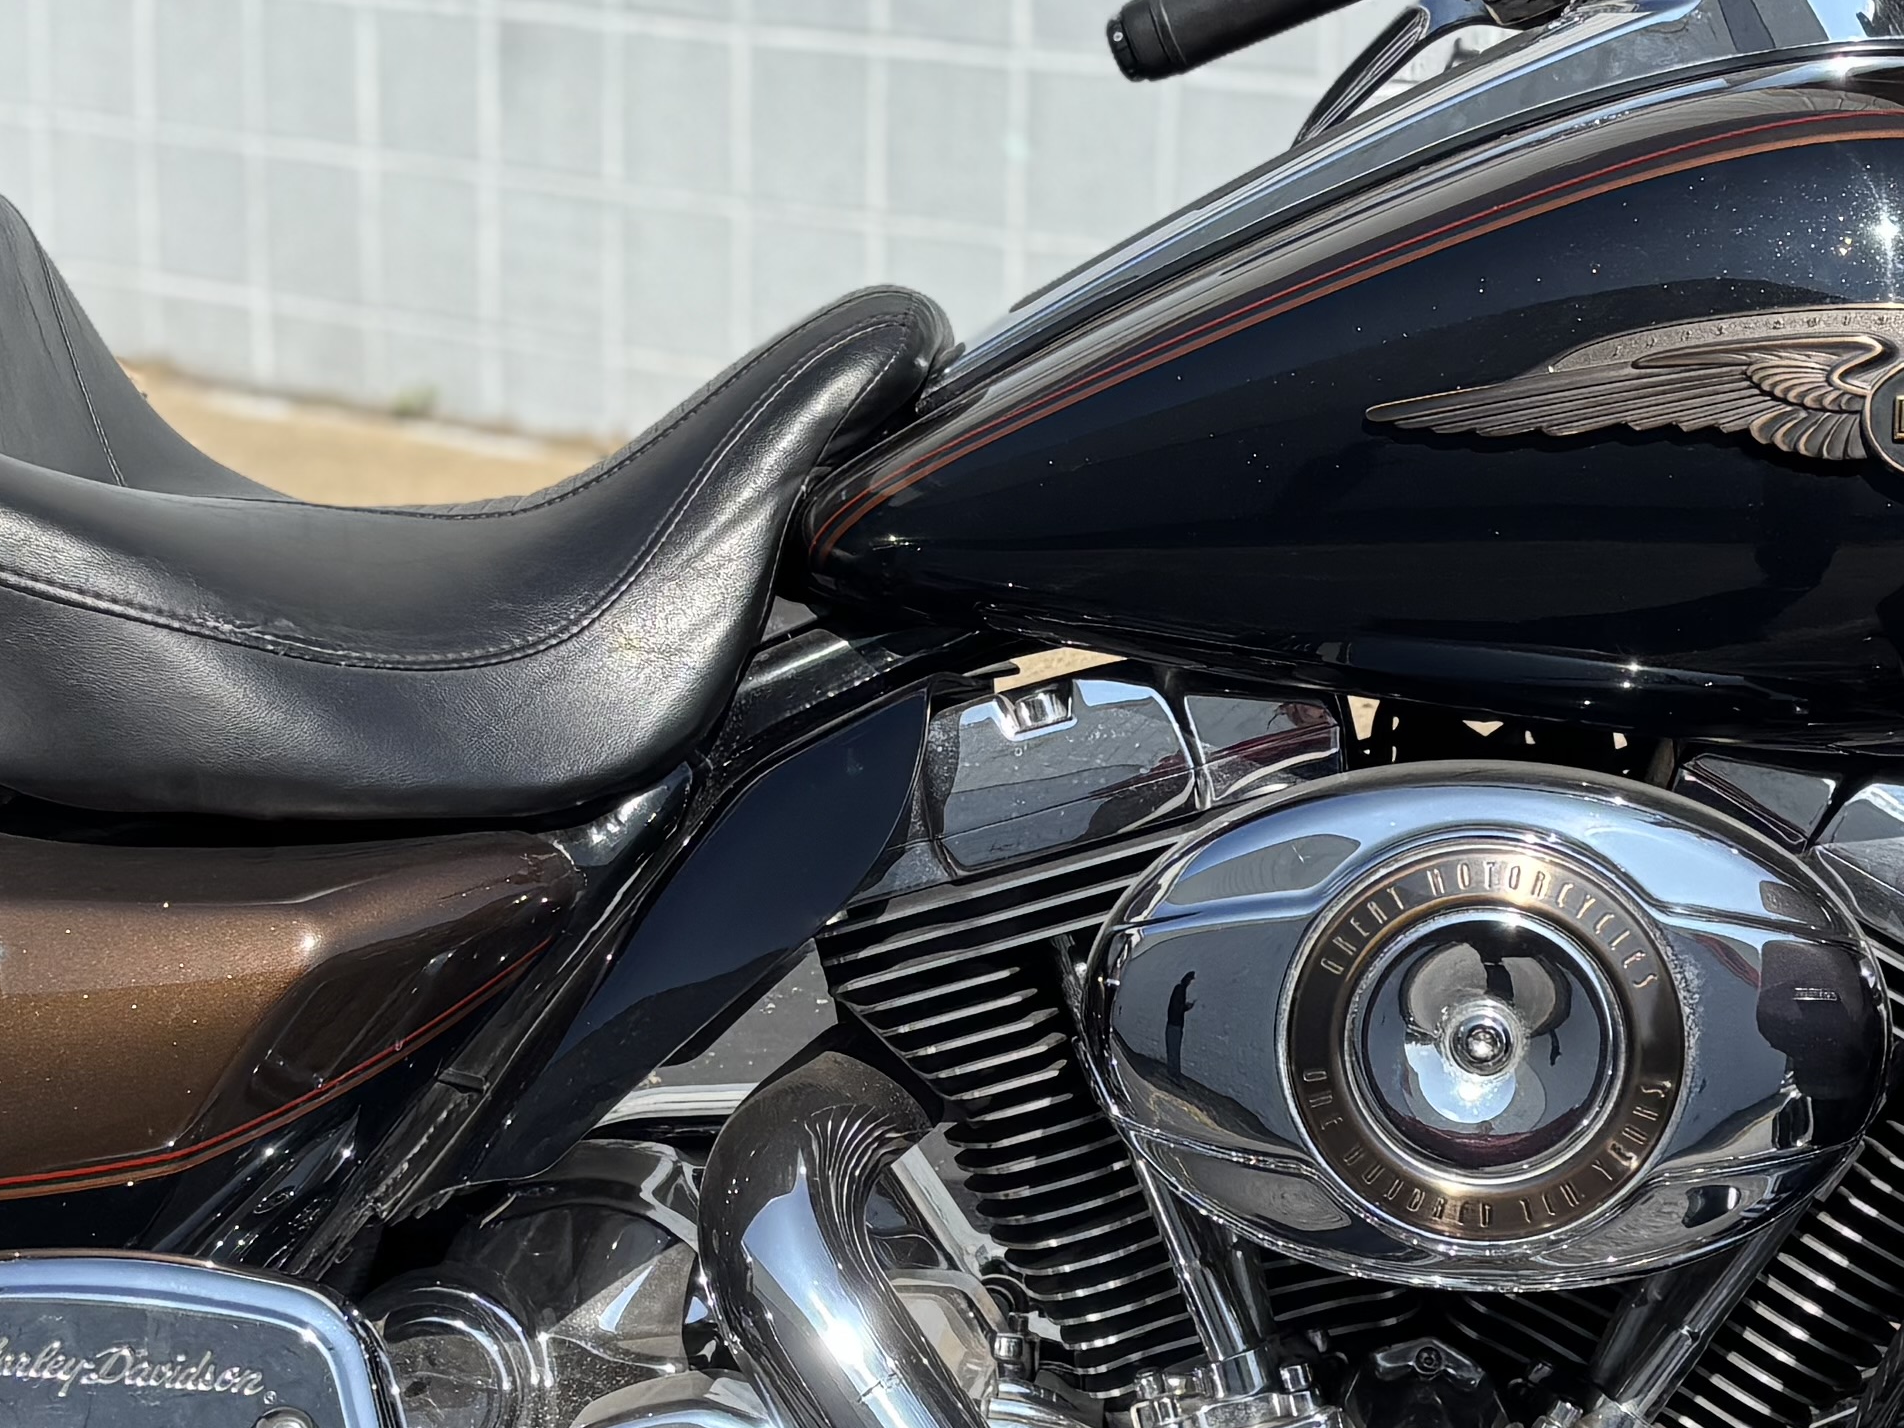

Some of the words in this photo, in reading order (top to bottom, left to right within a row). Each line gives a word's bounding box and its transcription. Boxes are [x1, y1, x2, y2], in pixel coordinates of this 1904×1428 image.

[1320, 887, 1405, 976] GREAT
[1426, 860, 1658, 990] MOTORCYCLES
[1302, 1068, 1344, 1132] ONE
[1591, 1078, 1672, 1181] YEARS
